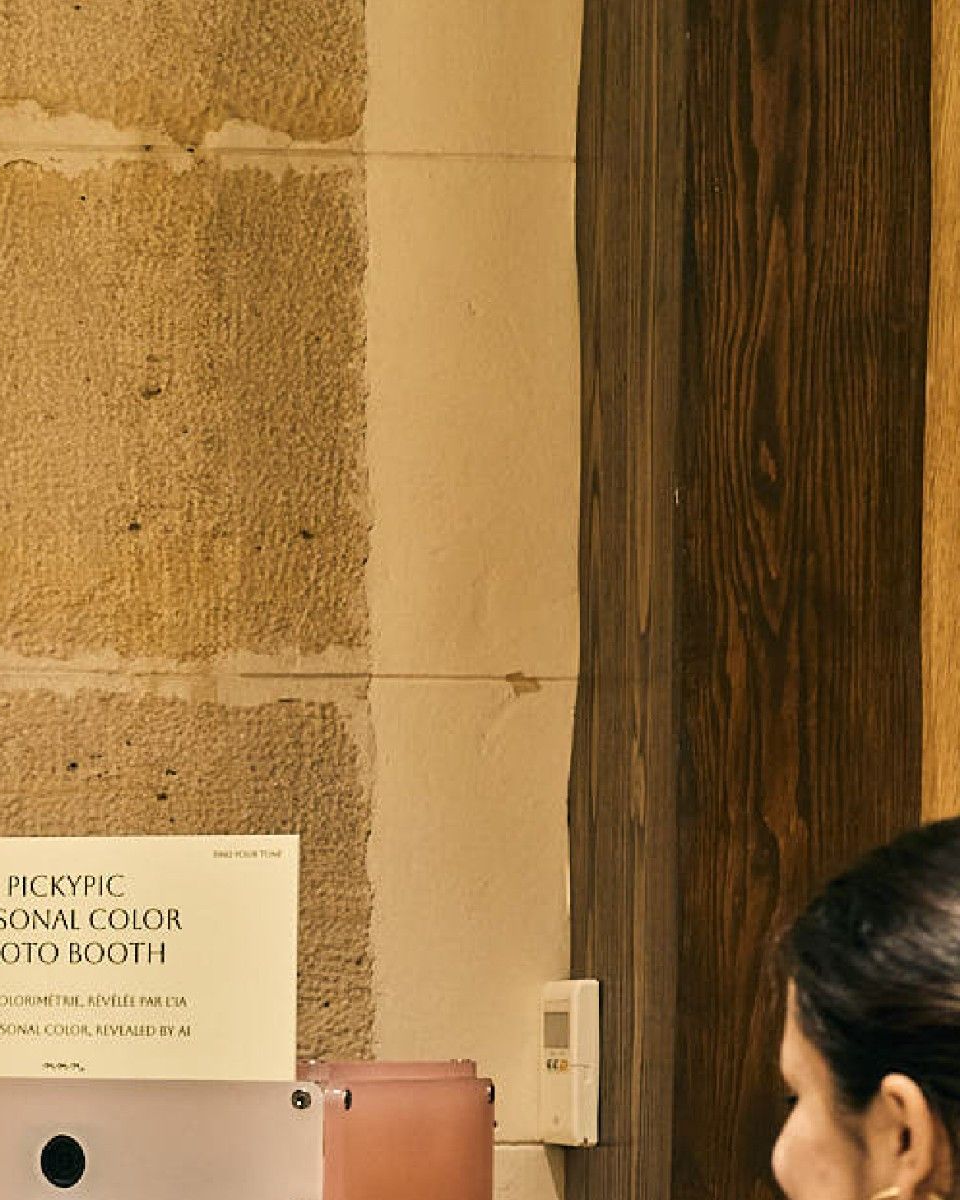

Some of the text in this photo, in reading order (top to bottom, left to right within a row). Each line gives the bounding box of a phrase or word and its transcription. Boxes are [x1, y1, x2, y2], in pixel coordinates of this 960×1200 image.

[7, 874, 126, 898] PICKYPIC
[88, 908, 183, 931] COLOR
[68, 941, 166, 965] BOOTH
[87, 992, 135, 1008] RÉVÉLÉE
[139, 996, 163, 1008] PAR
[43, 1024, 93, 1038] COLOR,
[96, 1025, 156, 1037] REVEALED
[159, 1025, 175, 1037] BY
[177, 1025, 191, 1037] AI
